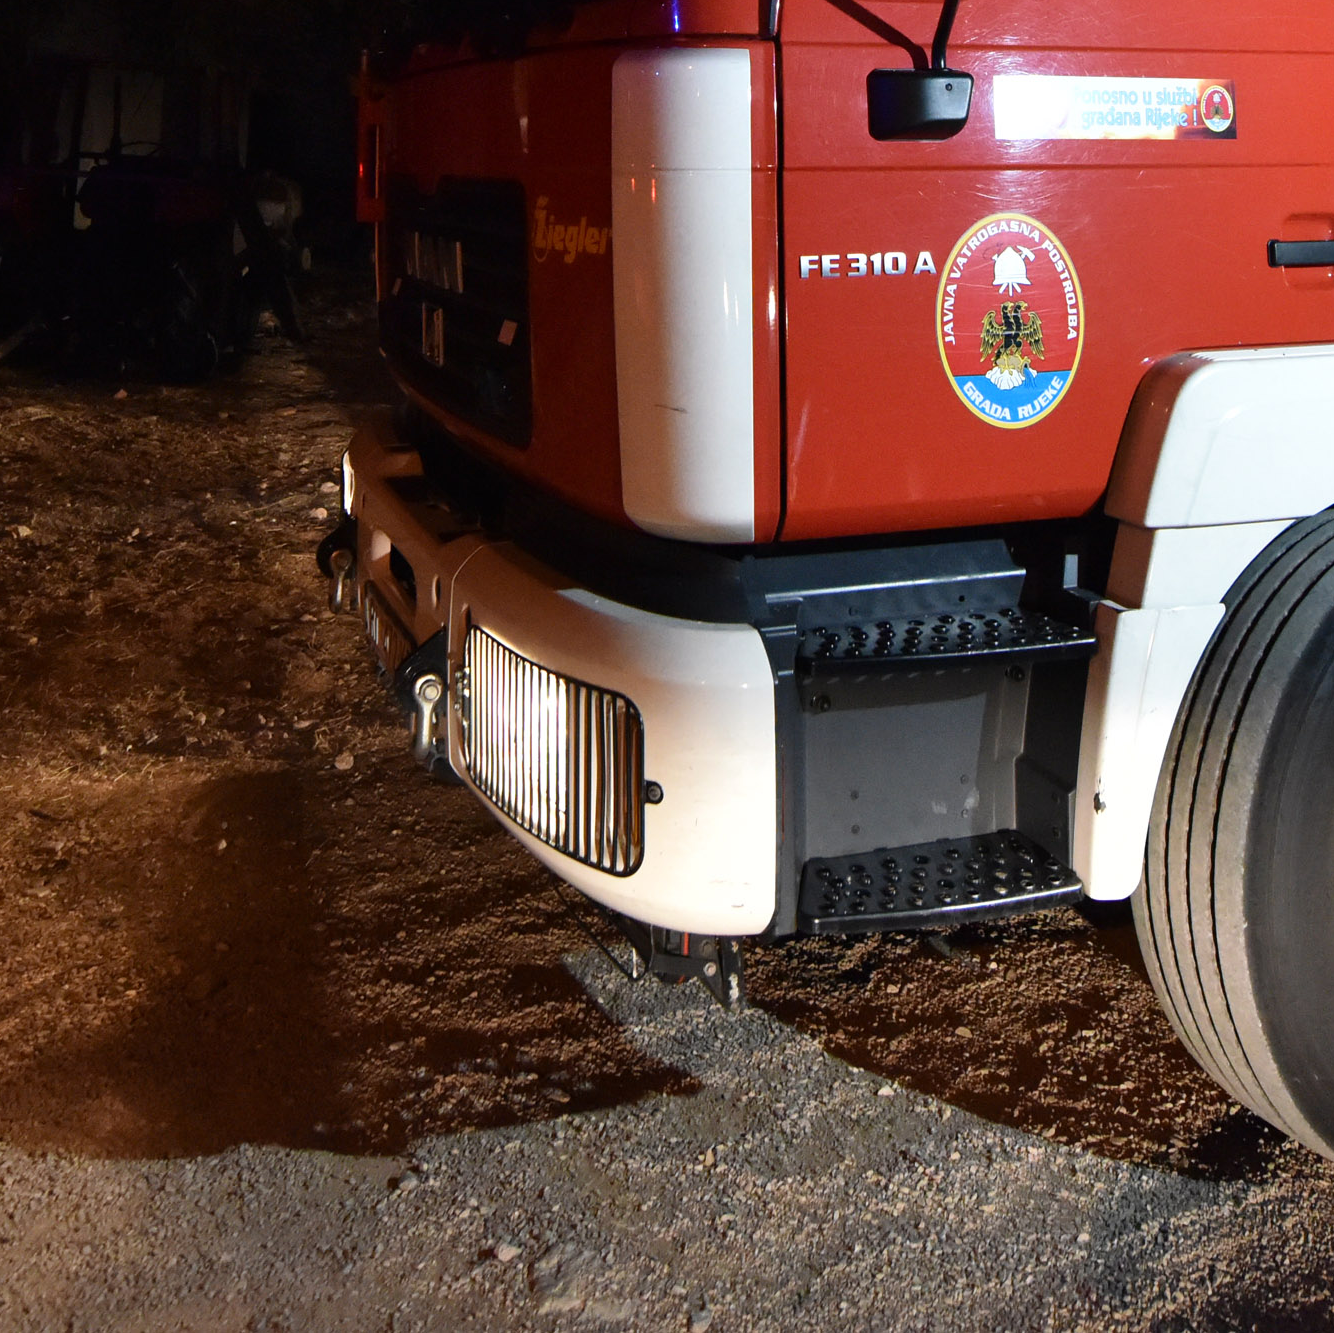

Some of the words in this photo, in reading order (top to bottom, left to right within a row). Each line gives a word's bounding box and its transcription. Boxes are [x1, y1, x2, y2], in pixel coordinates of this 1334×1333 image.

[1142, 90, 1153, 106] u
[1145, 107, 1188, 130] Rijeke
[800, 254, 841, 279] FE
[846, 251, 907, 277] 310
[913, 251, 937, 275] A
[942, 284, 958, 345] JAVNA
[950, 220, 1041, 279] VATROGASNA
[1041, 239, 1078, 340] POSTROJBA
[963, 381, 1012, 421] GRADA
[1018, 375, 1064, 420] RIJEKE
